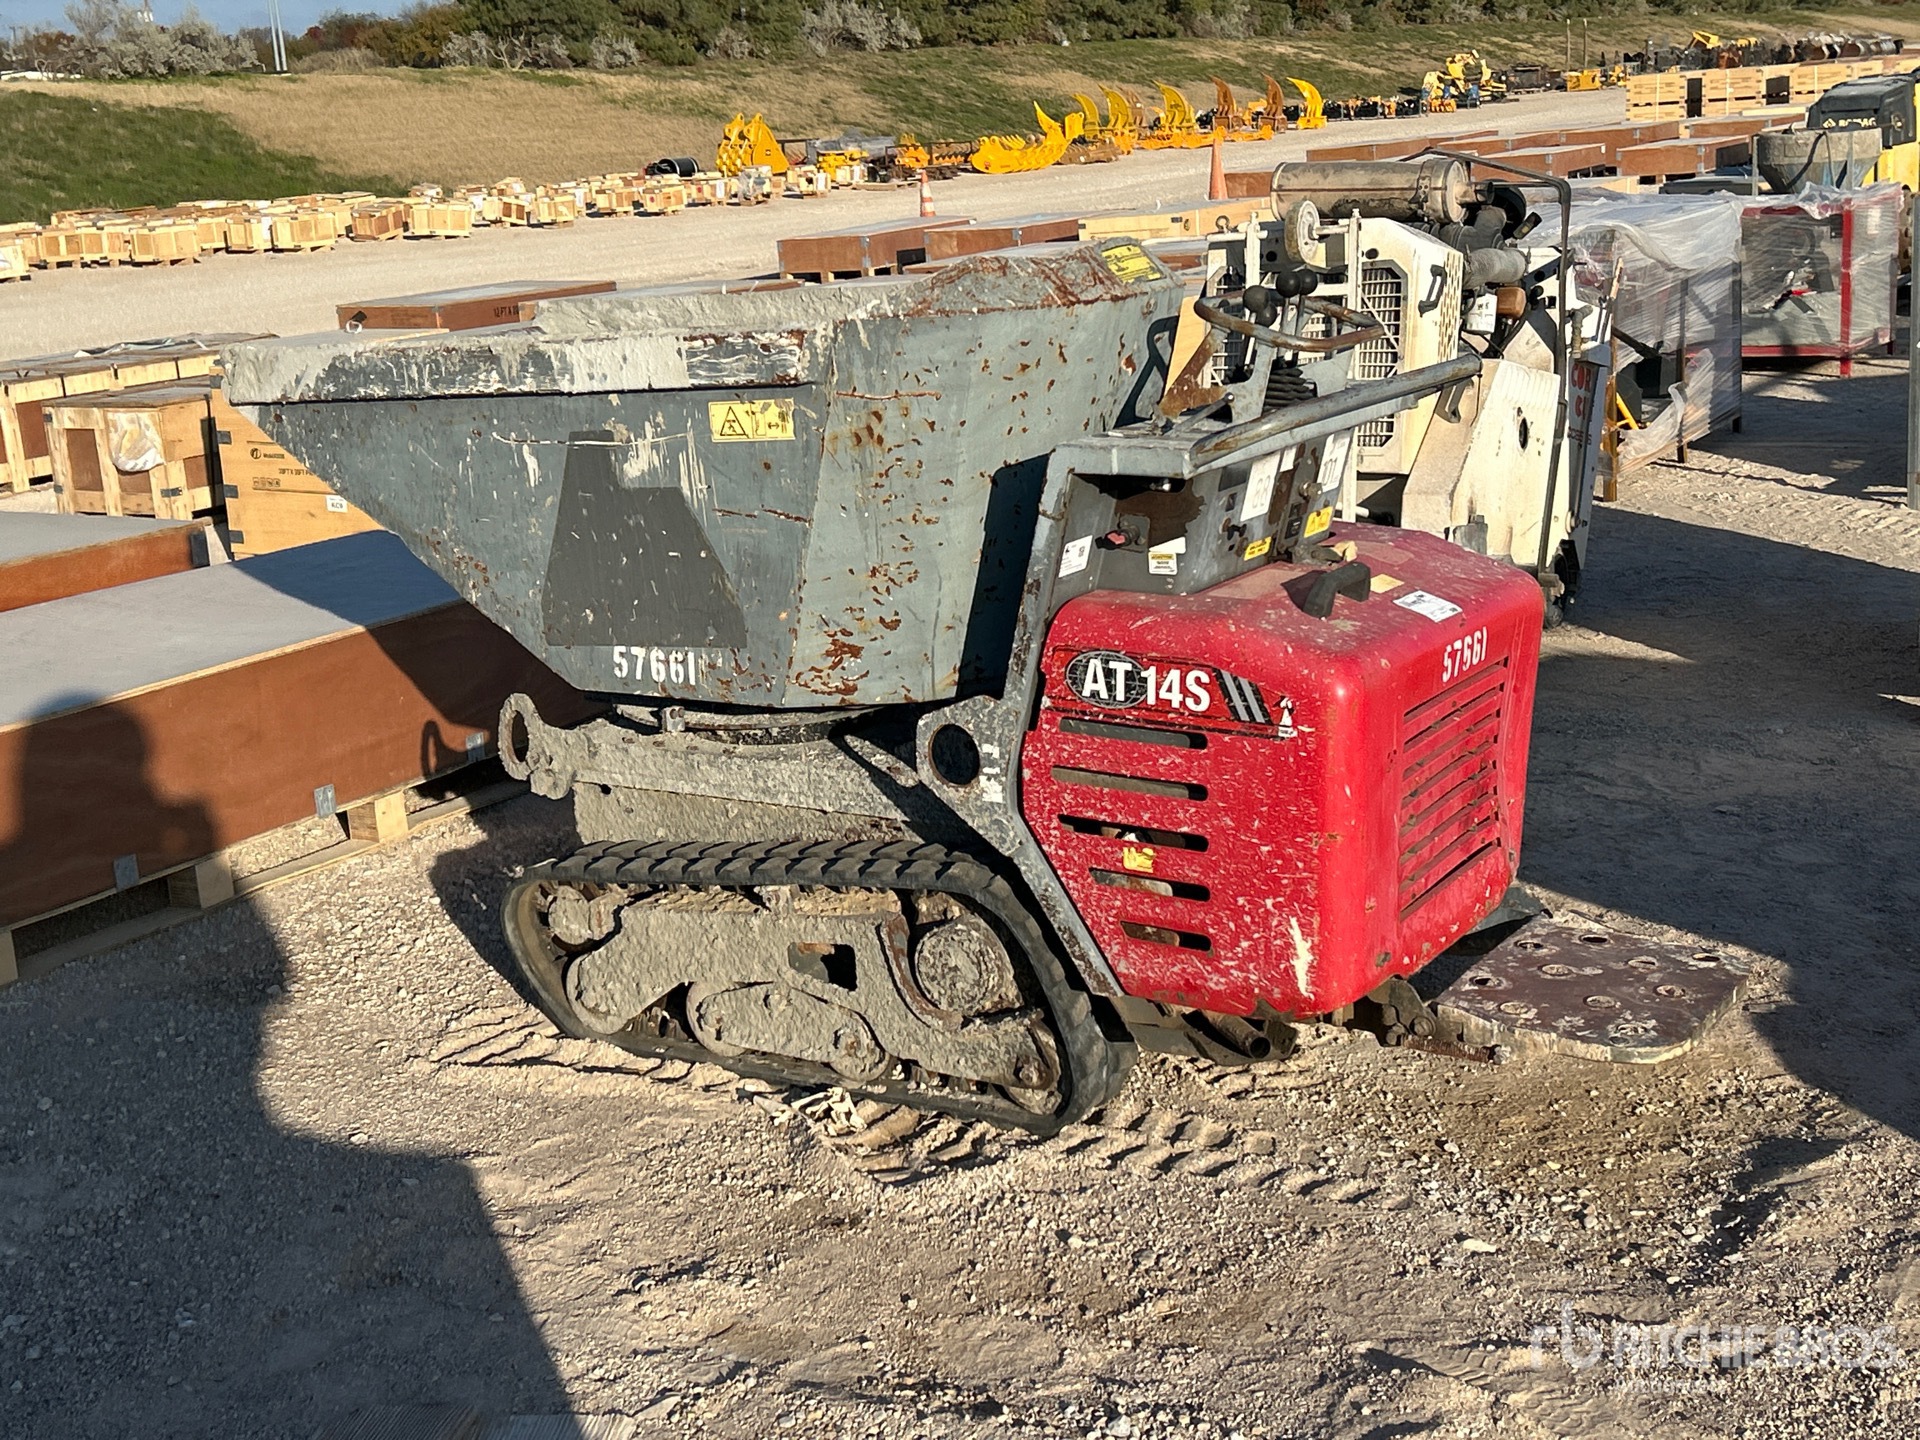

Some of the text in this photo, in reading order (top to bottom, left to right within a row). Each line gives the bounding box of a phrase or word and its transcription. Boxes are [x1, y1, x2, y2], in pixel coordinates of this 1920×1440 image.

[613, 645, 696, 686] 57661
[1442, 626, 1487, 683] 57661
[1081, 658, 1211, 713] AT 14S
